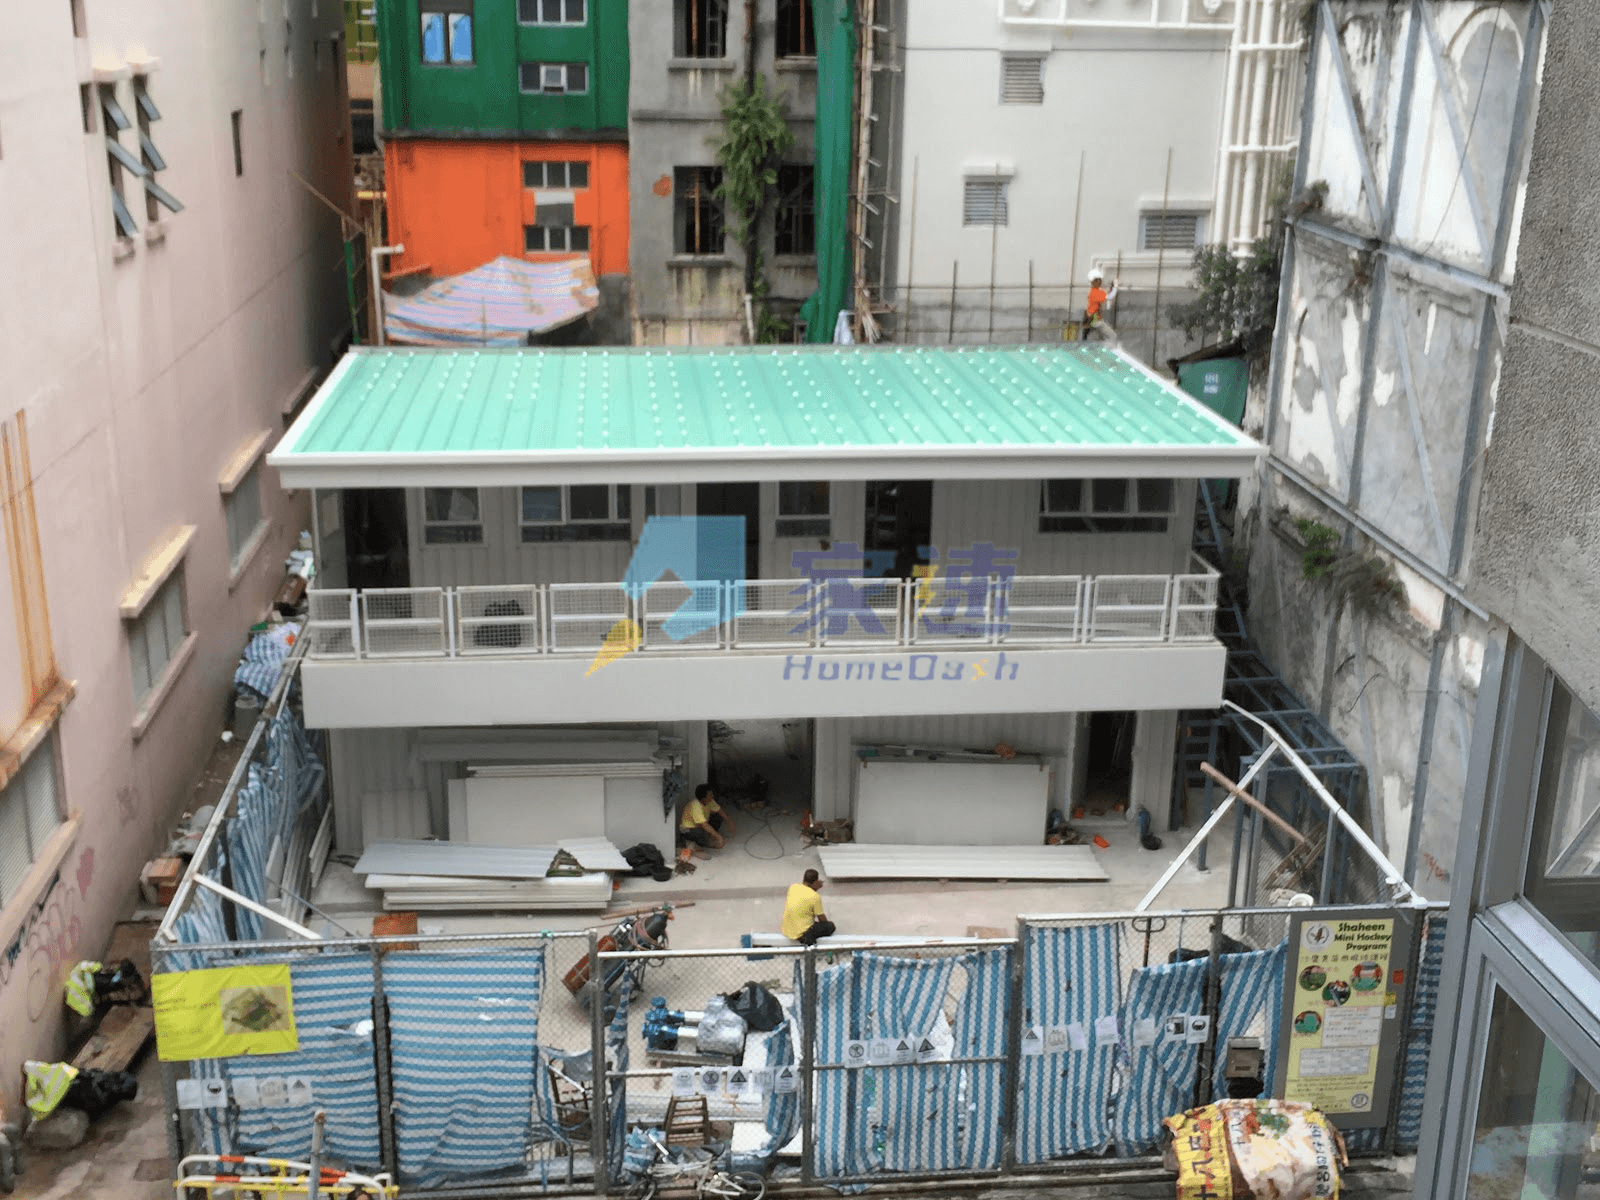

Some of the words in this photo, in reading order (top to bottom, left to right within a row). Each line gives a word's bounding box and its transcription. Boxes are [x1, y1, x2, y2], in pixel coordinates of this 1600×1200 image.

[1338, 922, 1386, 932] Shaheen
[1334, 934, 1354, 942] Mini
[1356, 933, 1392, 942] Hockey
[1346, 943, 1388, 951] Program
